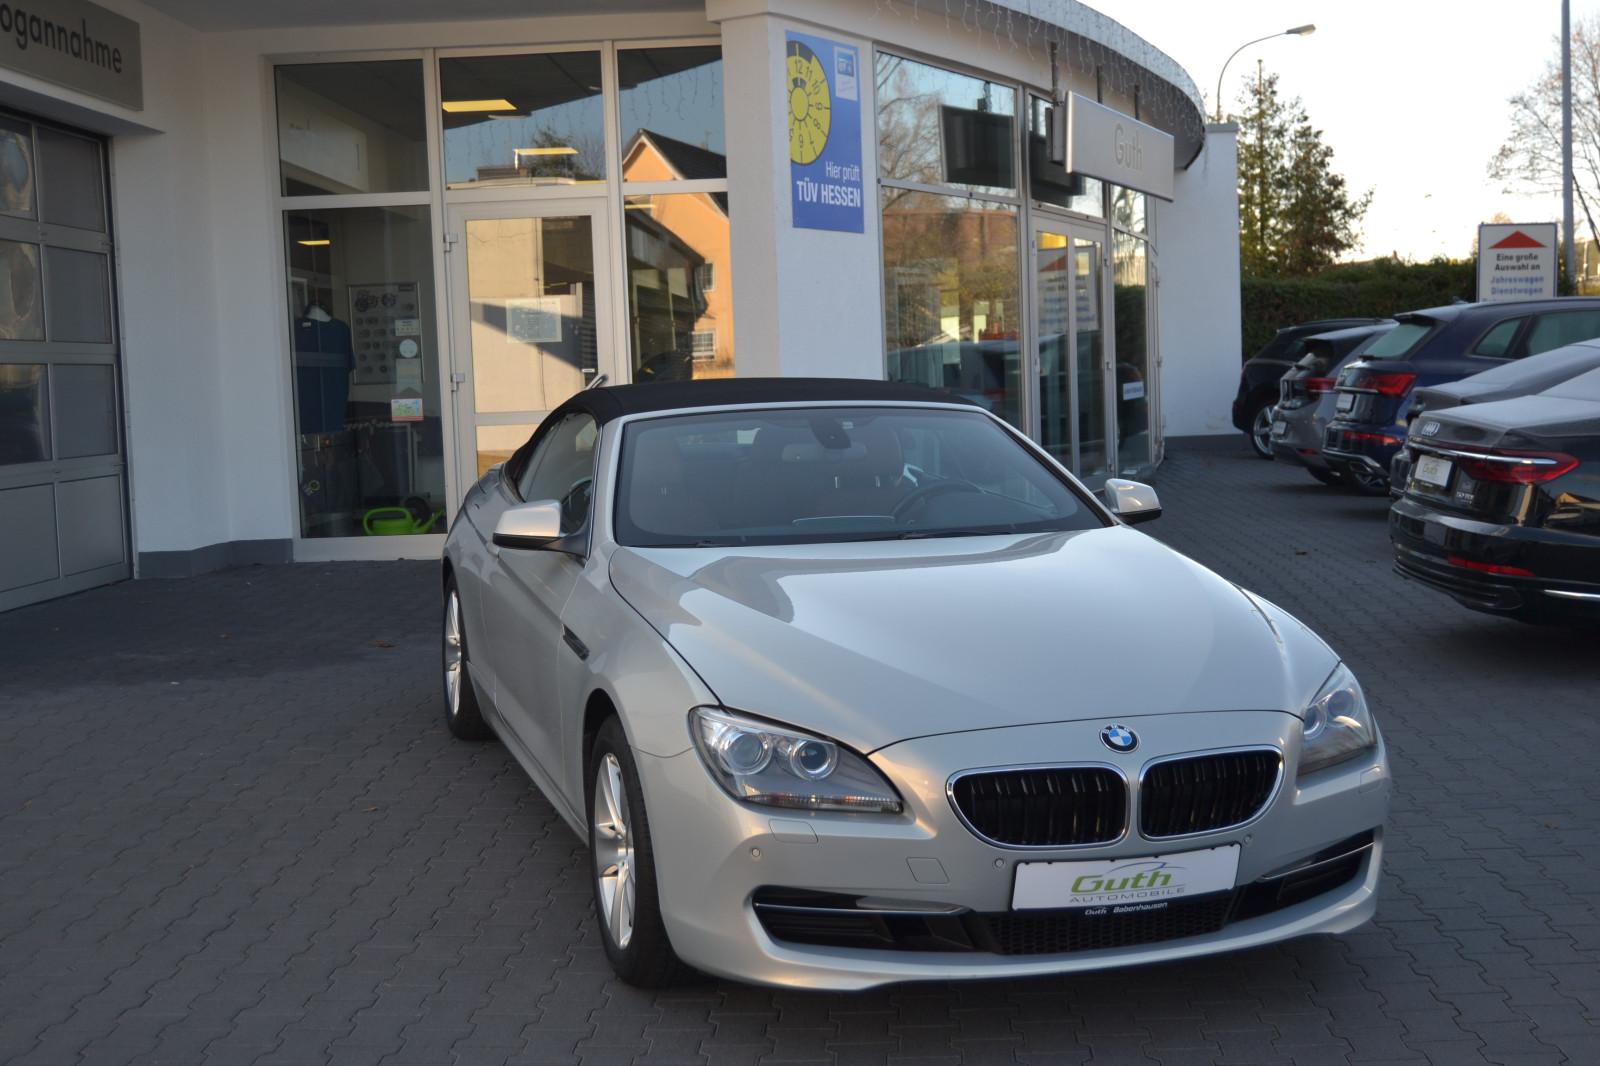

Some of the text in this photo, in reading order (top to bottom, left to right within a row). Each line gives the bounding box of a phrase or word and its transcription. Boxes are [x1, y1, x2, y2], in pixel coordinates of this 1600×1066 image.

[1113, 122, 1144, 171] Guth
[825, 160, 860, 183] Hier prüft
[796, 177, 861, 207] TÜV HESSEN
[1495, 263, 1528, 271] Auswahl
[1496, 253, 1538, 263] Eine große
[1071, 871, 1173, 893] Guth
[1069, 887, 1185, 903] AUTOMOBILE
[1113, 902, 1168, 914] Babenhausen
